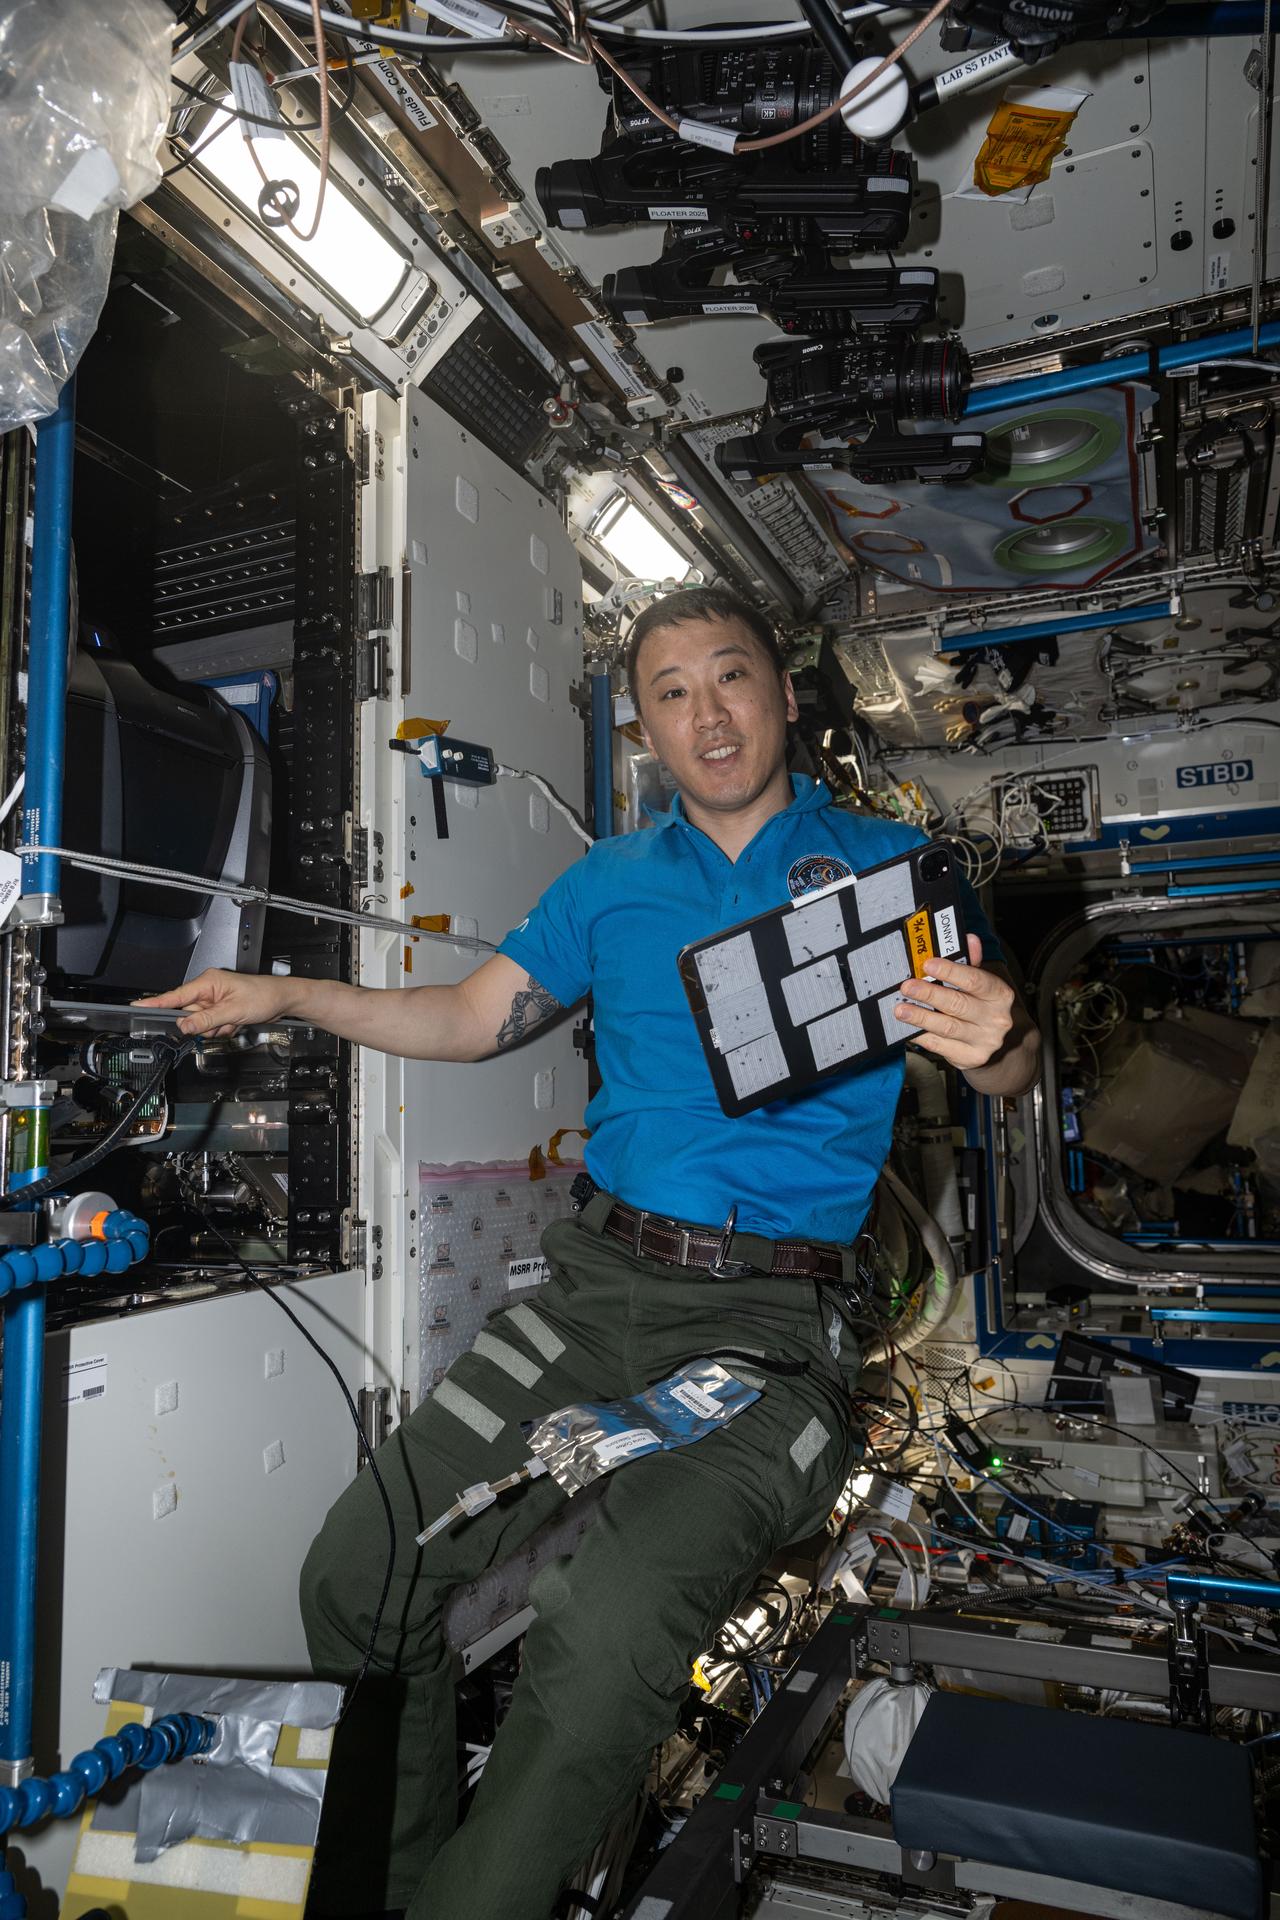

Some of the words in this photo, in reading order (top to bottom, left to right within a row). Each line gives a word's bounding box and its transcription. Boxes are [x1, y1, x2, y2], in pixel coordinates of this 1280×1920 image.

[1009, 0, 1074, 22] Canon
[941, 69, 963, 86] LAB
[965, 62, 978, 75] S5
[396, 88, 407, 96] &
[405, 97, 432, 127] Fluids
[763, 109, 775, 118] 4K
[623, 386, 637, 398] CIR
[1180, 762, 1249, 787] STBD
[940, 913, 953, 944] JONNY
[945, 946, 954, 954] 2
[509, 1263, 531, 1277] MSRR
